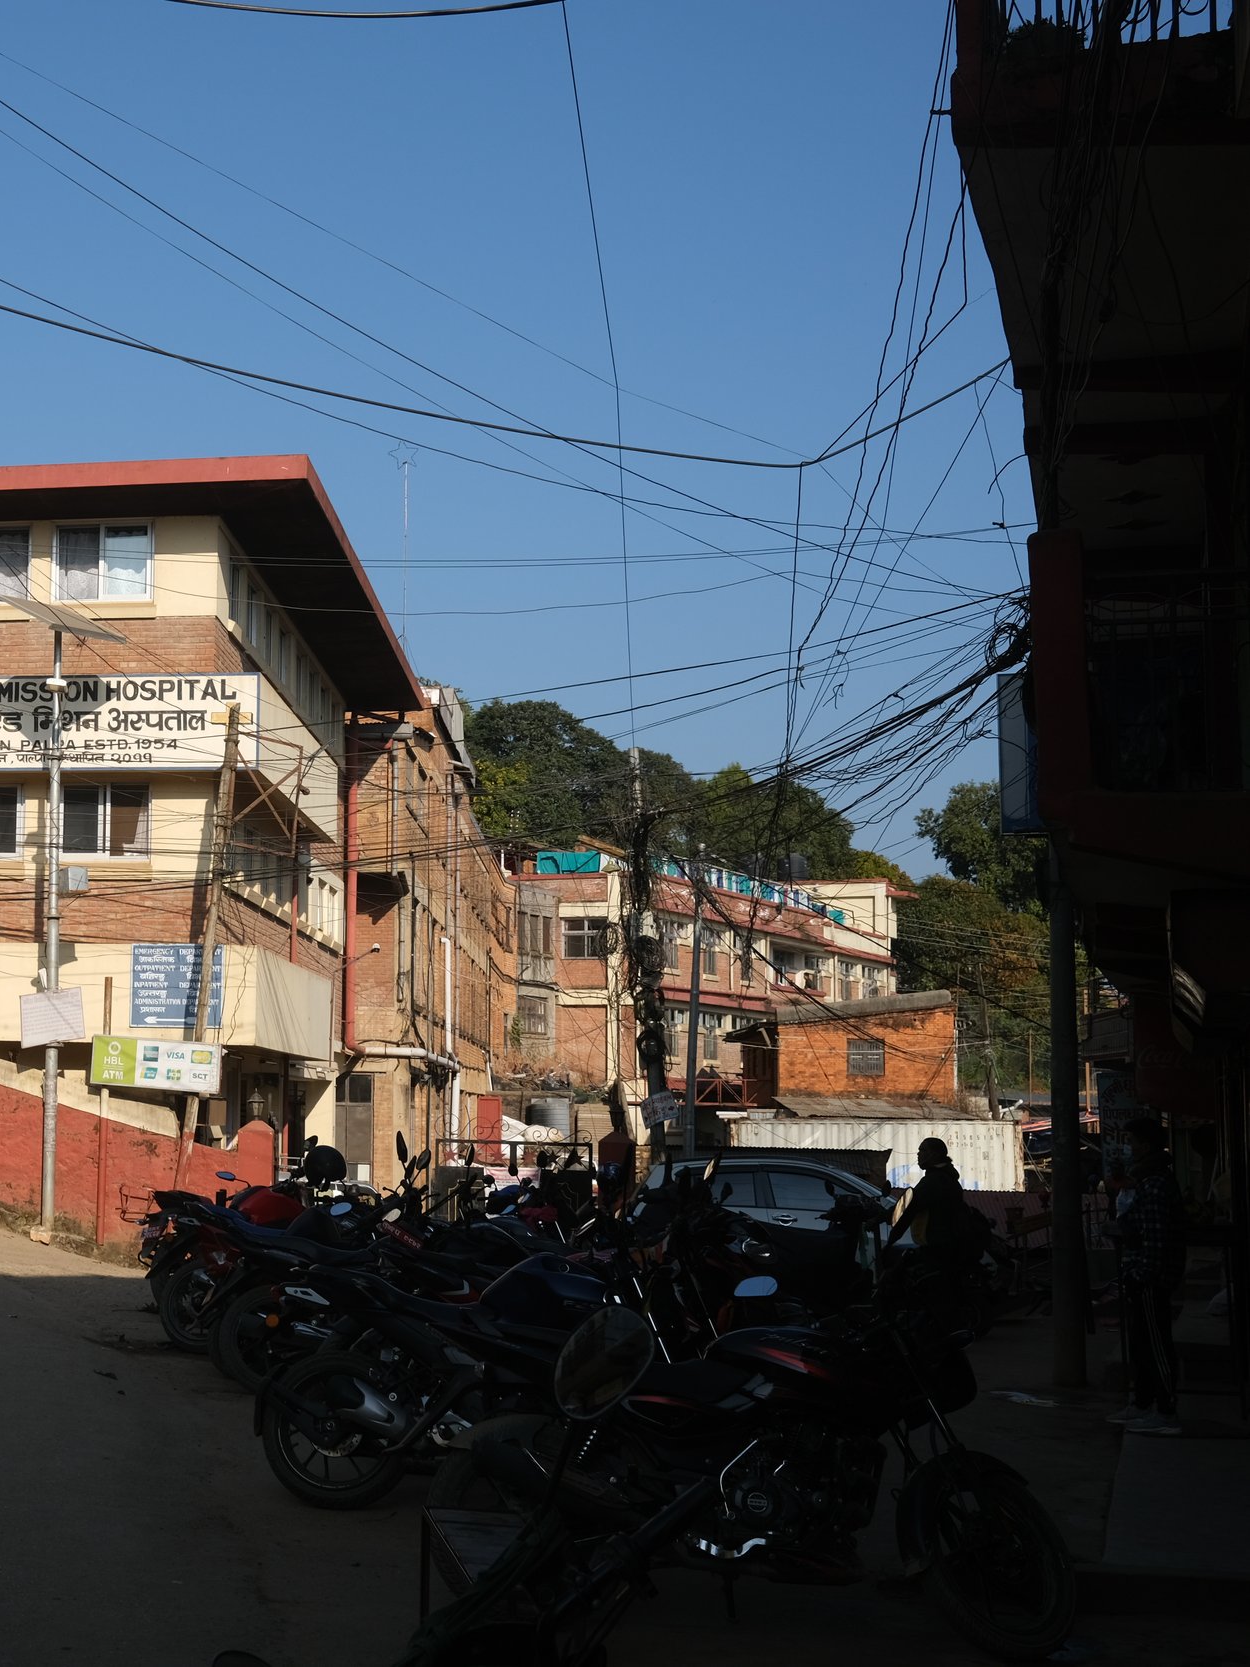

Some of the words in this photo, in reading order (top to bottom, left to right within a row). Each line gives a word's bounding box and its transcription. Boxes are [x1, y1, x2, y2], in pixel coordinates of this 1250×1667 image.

[105, 678, 237, 701] HOSPITAL
[108, 707, 208, 733] अस्पताल
[166, 1051, 185, 1060] VISA
[103, 1056, 124, 1065] HBL
[102, 1070, 124, 1080] ATM
[192, 1072, 208, 1080] SCT
